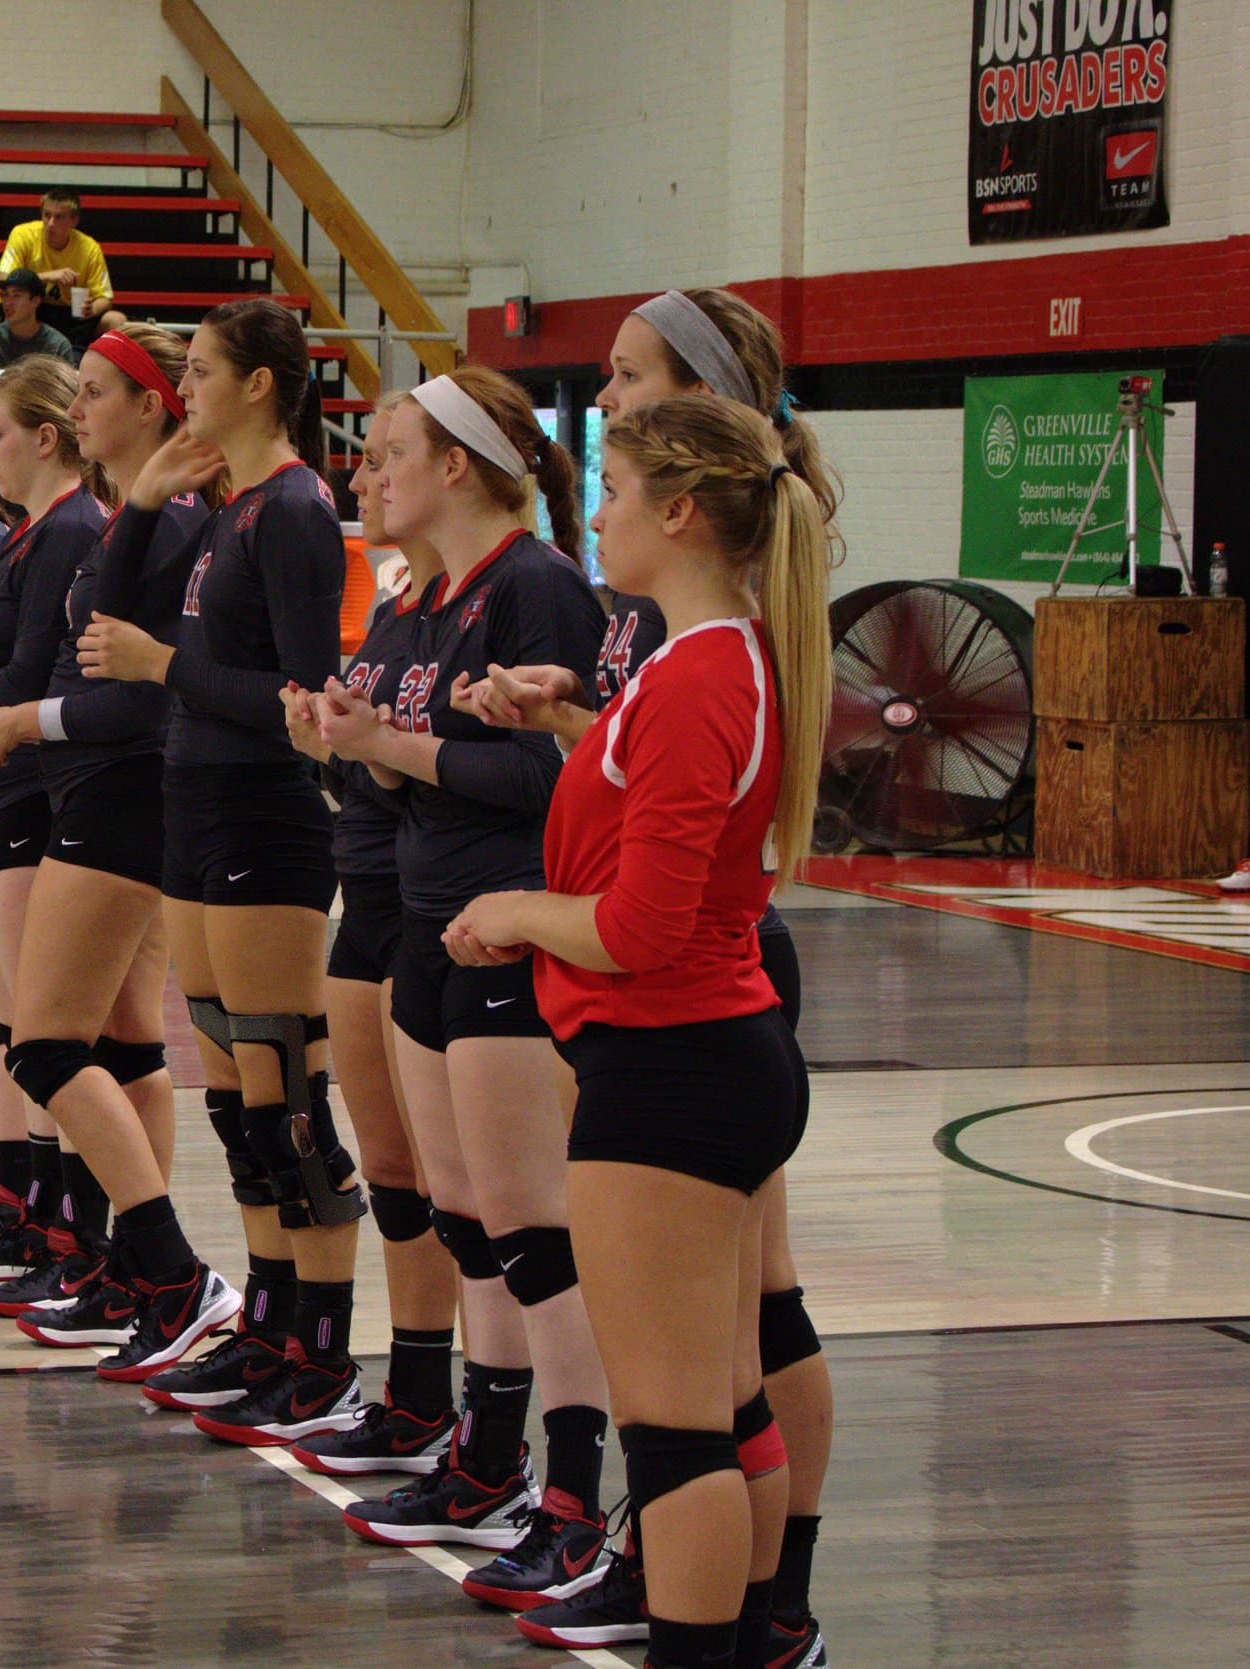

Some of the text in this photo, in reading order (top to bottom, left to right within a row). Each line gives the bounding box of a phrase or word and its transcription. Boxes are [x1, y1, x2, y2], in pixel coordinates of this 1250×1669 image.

[978, 39, 1167, 127] CRUSADERS
[1111, 181, 1151, 197] TEAM
[1049, 296, 1081, 336] EXIT
[1023, 413, 1113, 437] GREENVILLE
[988, 447, 1011, 466] GHS
[1024, 443, 1074, 467] HEALTH
[1019, 480, 1111, 500] Steadman Hawkns
[1017, 507, 1050, 529] Sports
[395, 662, 438, 735] 22
